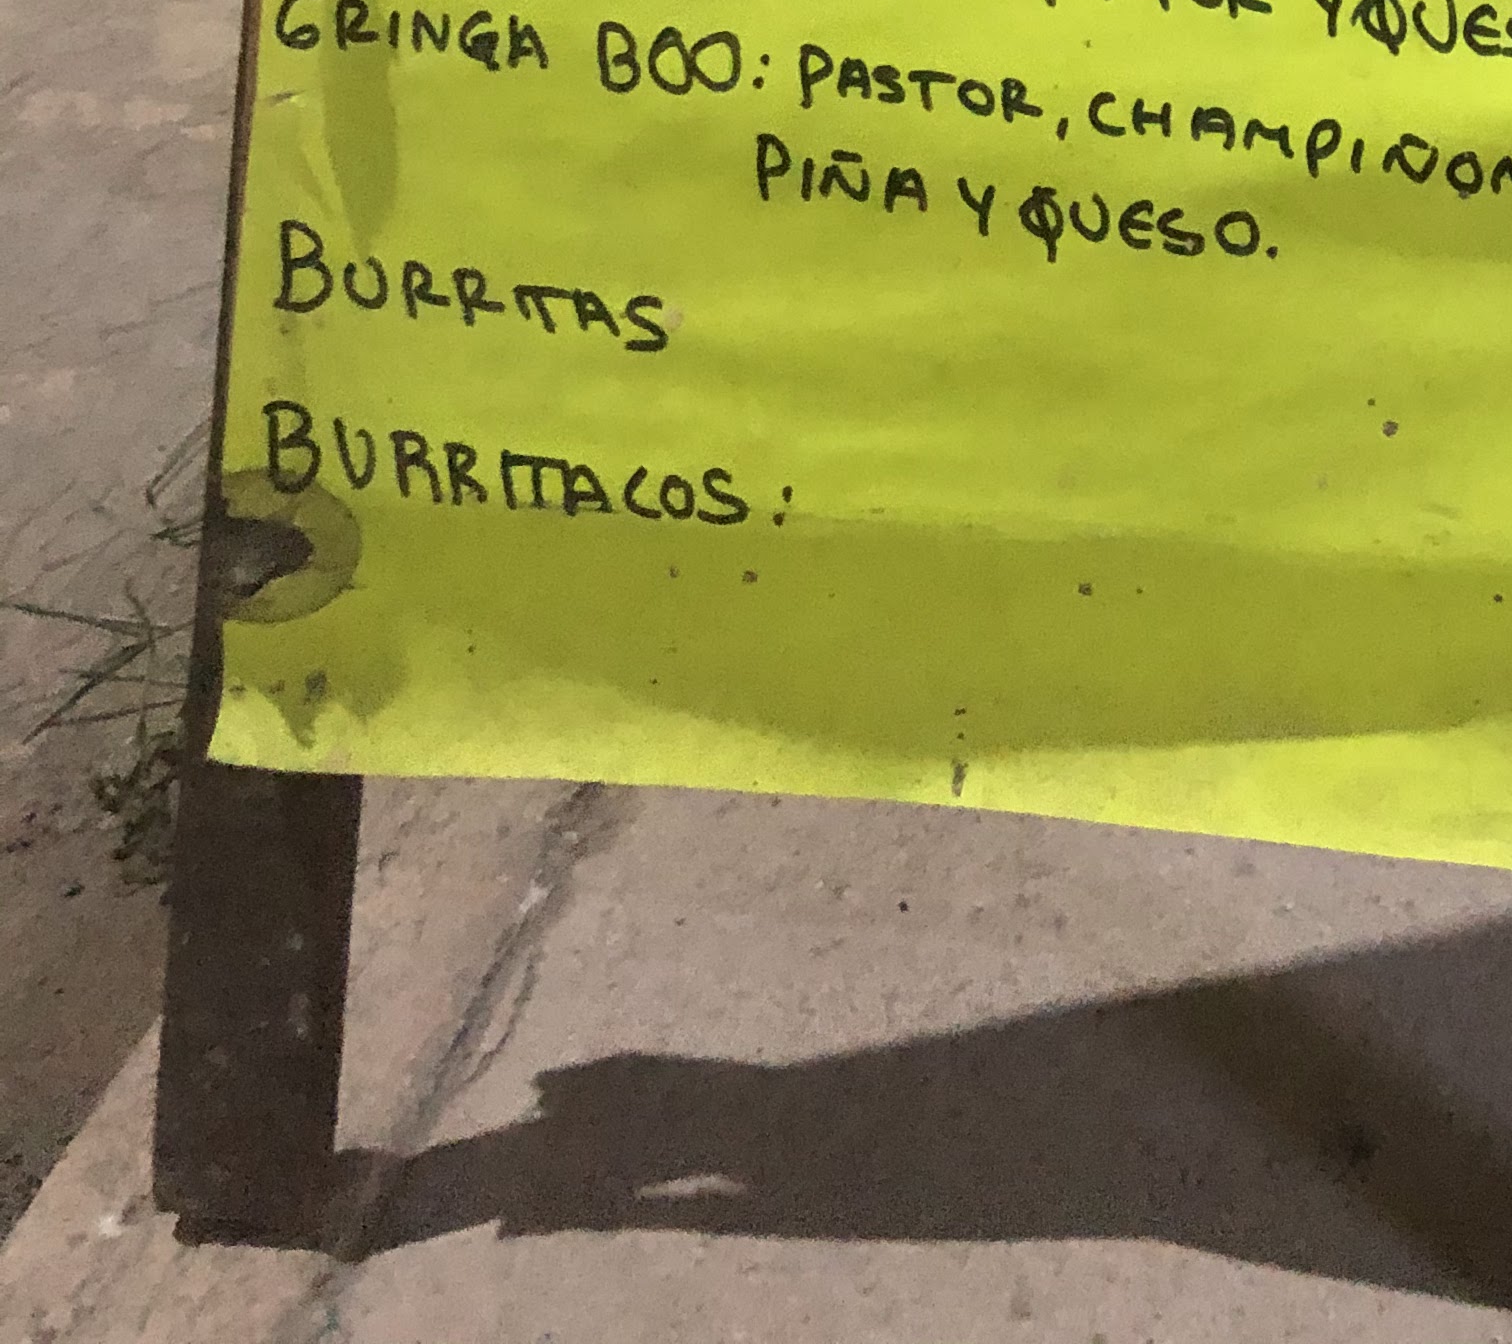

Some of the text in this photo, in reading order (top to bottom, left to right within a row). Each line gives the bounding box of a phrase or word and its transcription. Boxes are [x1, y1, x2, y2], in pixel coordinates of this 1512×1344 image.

[597, 21, 769, 95] BOO:
[757, 134, 927, 213] PIÑA
[957, 178, 995, 236] Y
[273, 220, 668, 352] BURRITAS
